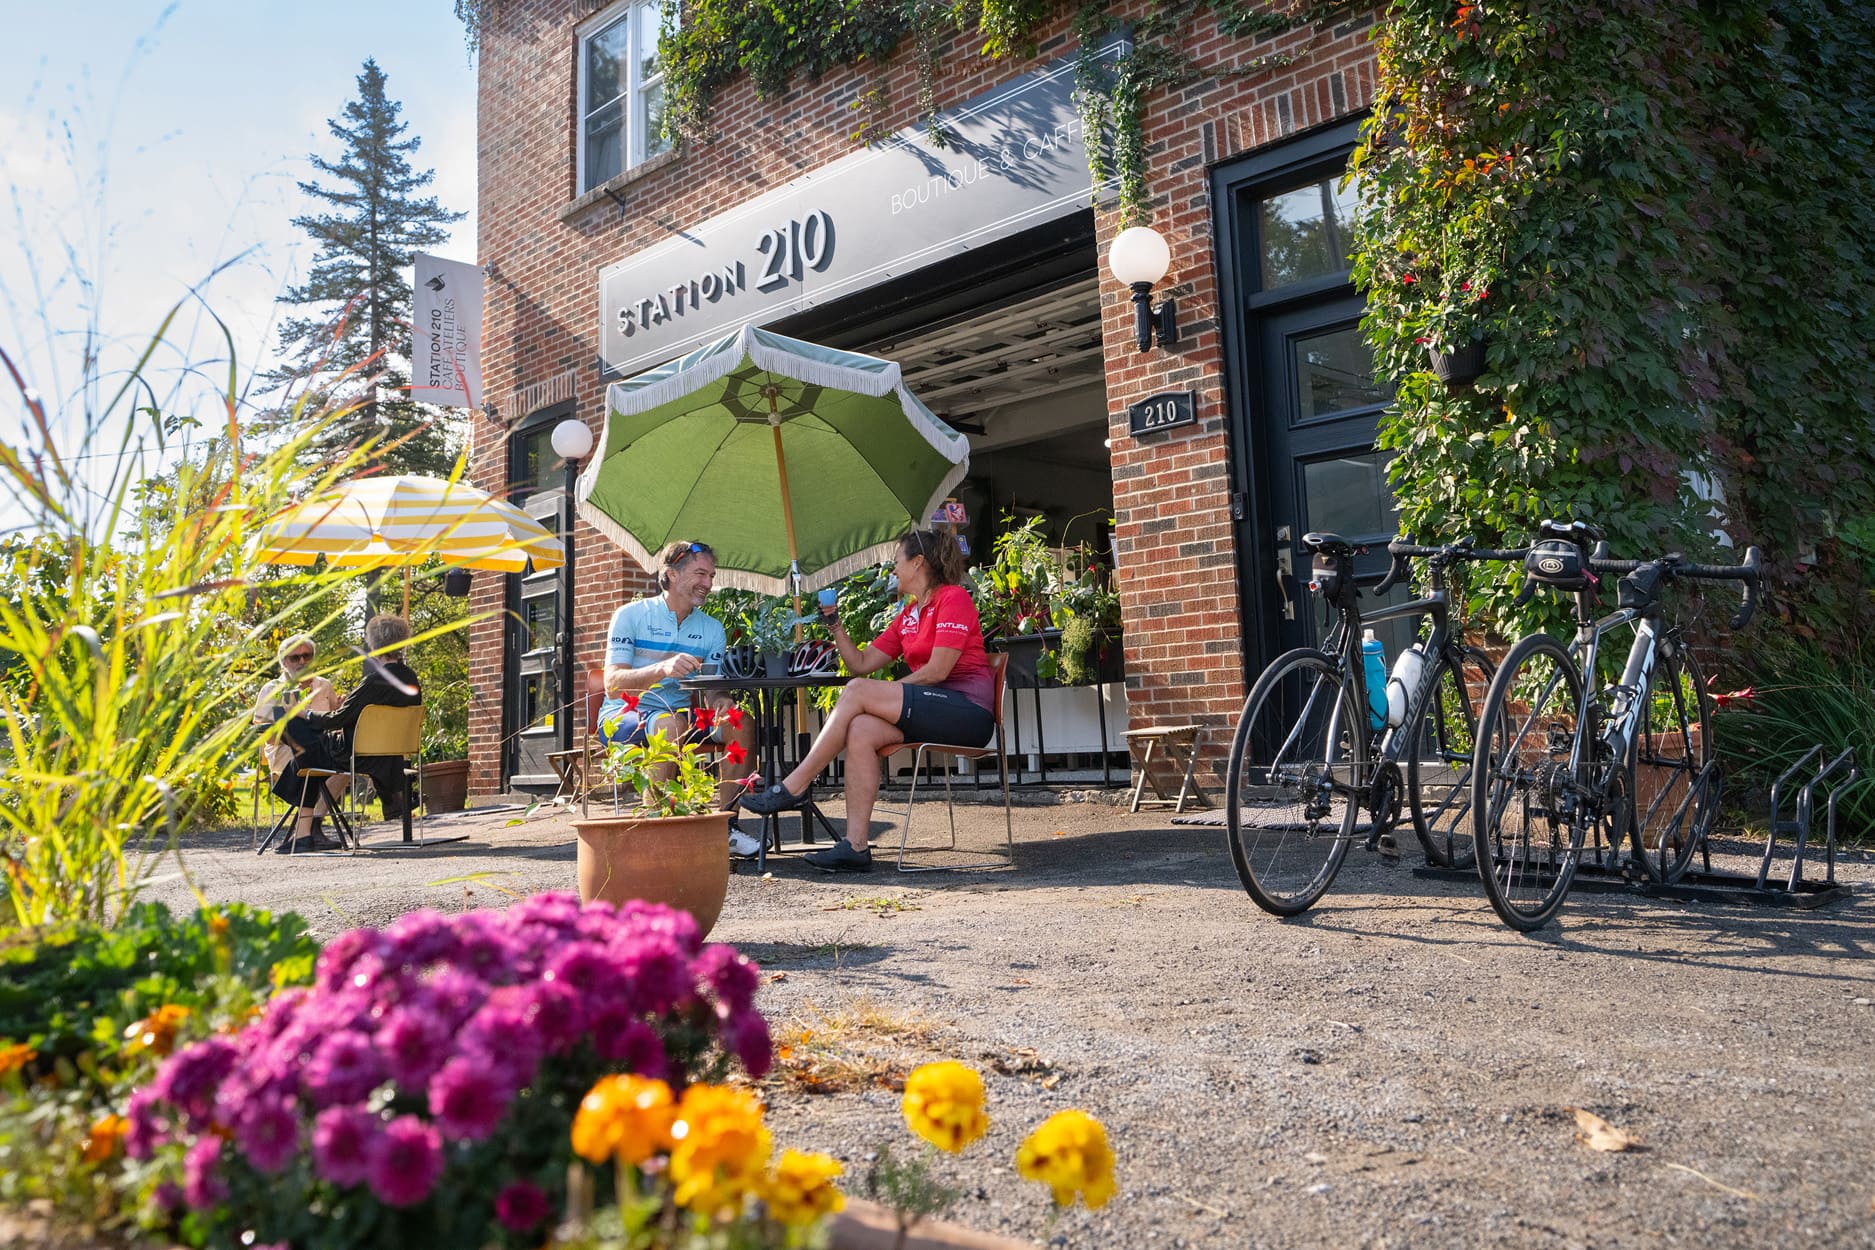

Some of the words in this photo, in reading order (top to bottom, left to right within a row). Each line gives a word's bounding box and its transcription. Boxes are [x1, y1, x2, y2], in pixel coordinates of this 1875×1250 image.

[891, 156, 990, 215] BOUTIQUE
[1000, 149, 1014, 170] &
[617, 260, 742, 336] STATION
[755, 208, 831, 291] 210
[432, 309, 442, 331] 210
[443, 298, 455, 353] ATELIERS
[430, 333, 441, 388] STATION
[1144, 400, 1177, 427] 210
